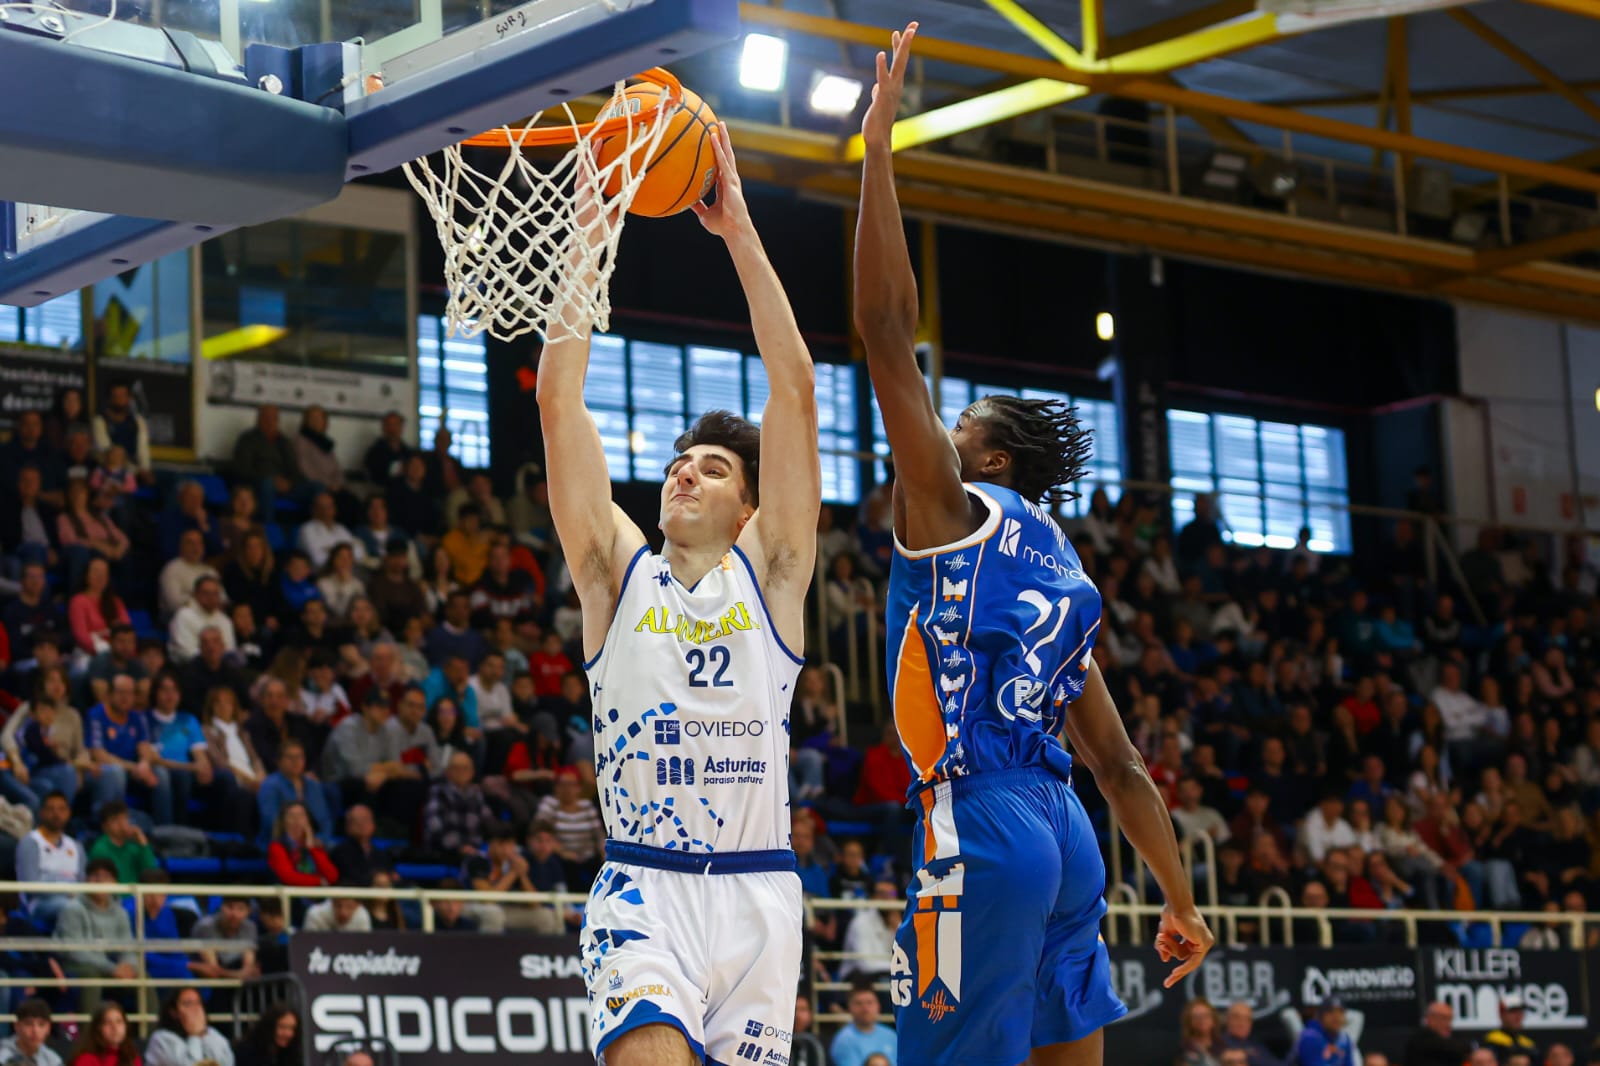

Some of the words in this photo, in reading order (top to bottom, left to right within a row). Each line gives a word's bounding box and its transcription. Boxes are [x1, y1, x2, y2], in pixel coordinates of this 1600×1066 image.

[685, 645, 734, 687] 22
[684, 719, 764, 737] OVIEDO
[703, 755, 767, 773] Asturias
[308, 947, 331, 973] tu
[520, 954, 584, 979] SHA
[1433, 949, 1521, 979] KILLER
